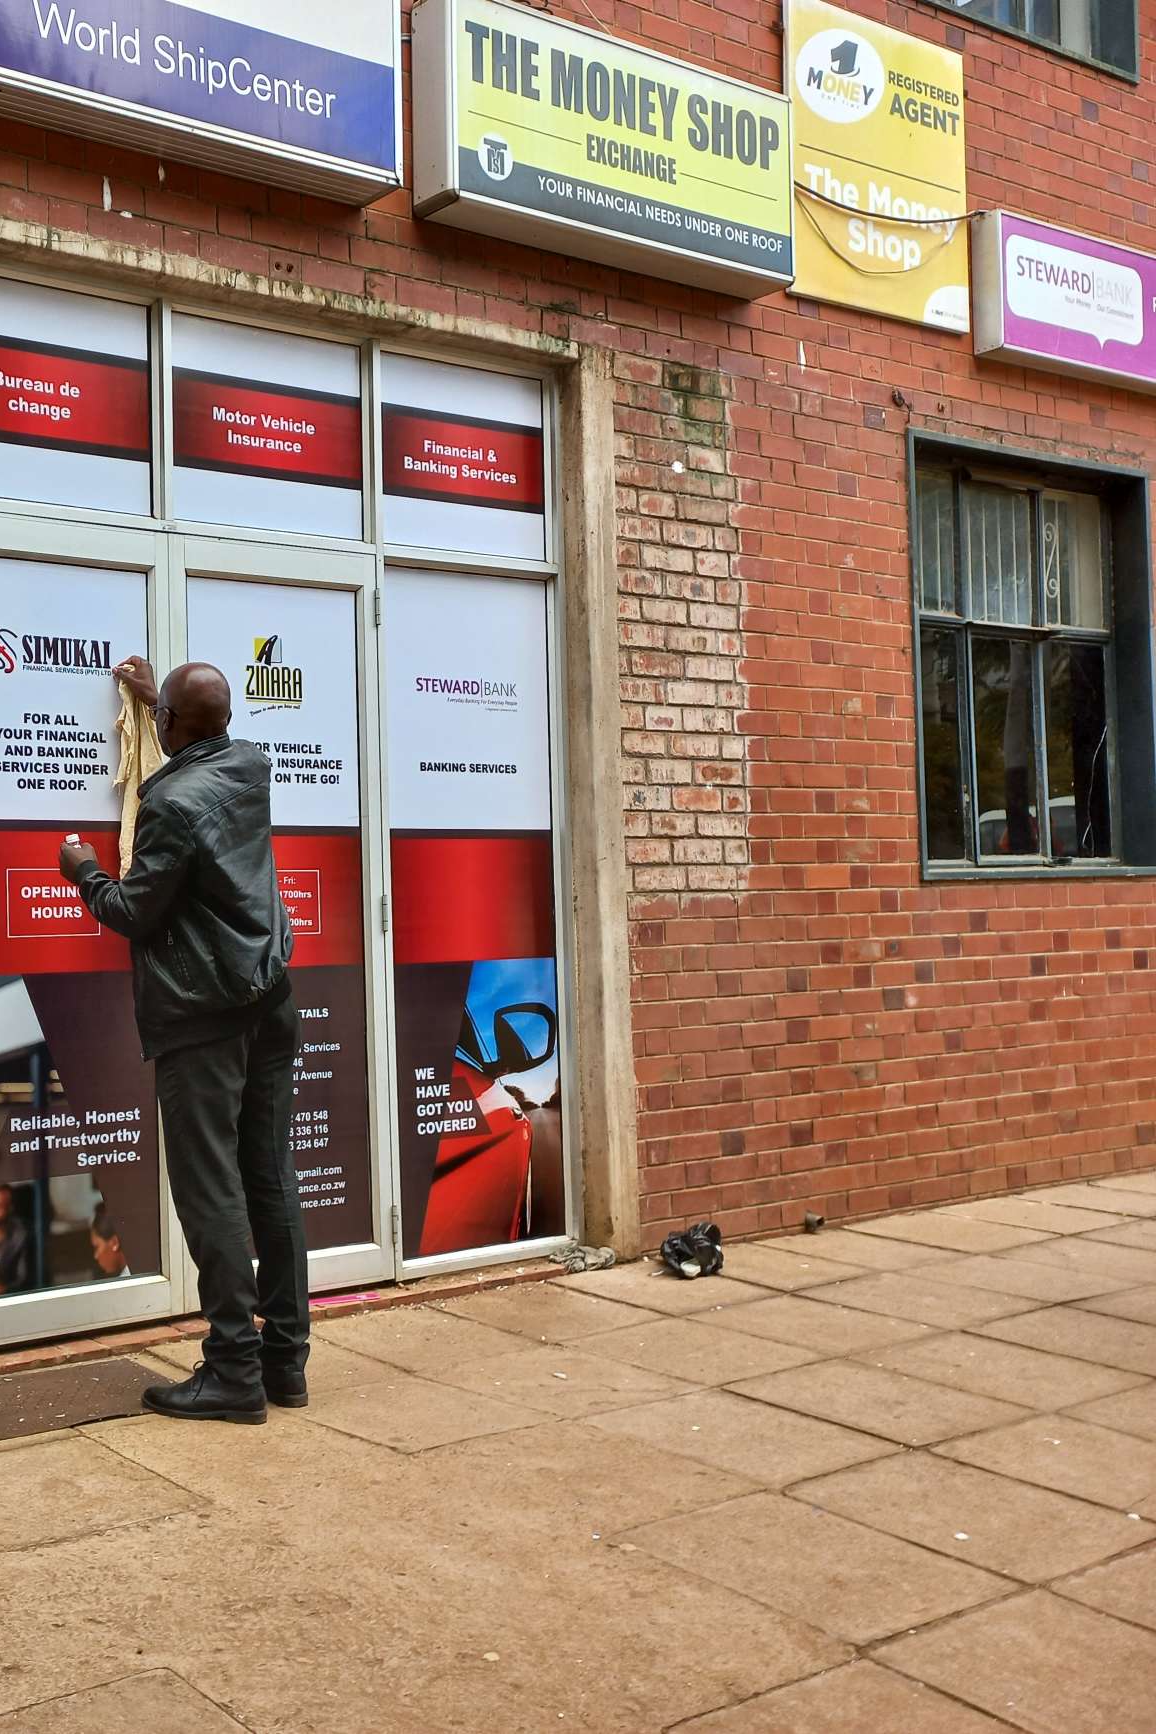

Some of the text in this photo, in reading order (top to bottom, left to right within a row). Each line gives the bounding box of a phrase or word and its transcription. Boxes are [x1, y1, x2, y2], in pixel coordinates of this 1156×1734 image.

[32, 0, 336, 119] World ShipCenter
[465, 20, 779, 170] THE MONEY SHOP
[807, 67, 874, 106] MONEY
[888, 71, 959, 107] REGISTERED
[889, 93, 960, 136] AGENT
[586, 133, 677, 186] EXCHANGE
[804, 163, 958, 244] The Money
[538, 175, 783, 254] YOUR FINANCIAL NEEDS UNDER ONE ROOF
[848, 217, 921, 271] Shop
[1016, 255, 1091, 294] STEWARD
[1096, 276, 1132, 307] BANK
[59, 381, 80, 399] de
[8, 397, 71, 421] change
[212, 406, 315, 436] Motor Vehicle
[227, 429, 302, 454] Insurance
[423, 439, 497, 463] Financial &
[404, 456, 517, 485] Banking Services
[22, 635, 111, 669] SIMUKAI
[22, 664, 53, 673] FINANCIAL
[55, 667, 84, 675] SERVICES
[85, 668, 100, 676] (PVT)
[246, 665, 302, 699] ZINARA
[416, 677, 518, 697] STEWARD BANK
[23, 713, 78, 726] FOR ALL
[37, 730, 106, 743] FINANCIAL
[4, 745, 97, 759] AND BANKING
[274, 743, 322, 755] VEHICLE
[64, 763, 108, 775] UNDER
[277, 758, 343, 770] INSURANCE
[420, 761, 517, 774] BANKING SERVICES
[17, 778, 87, 791] ONE ROOF.
[275, 773, 340, 784] ON THE GO!
[283, 876, 296, 885] Fri:
[31, 906, 83, 919] HOURS
[298, 1008, 329, 1019] TAILS
[303, 1042, 341, 1053] Services
[300, 1070, 333, 1080] Avenue
[415, 1067, 435, 1081] WE
[416, 1084, 450, 1099] HAVE
[295, 1112, 311, 1122] 470
[417, 1100, 473, 1117] GOT YOU
[10, 1107, 140, 1132] Reliable, Honest
[417, 1117, 477, 1135] COVERED
[296, 1126, 312, 1136] 336
[314, 1124, 328, 1134] 116
[10, 1128, 141, 1153] and Trustworthy
[296, 1139, 312, 1150] 234
[313, 1137, 329, 1148] 647
[77, 1150, 141, 1167] Service.
